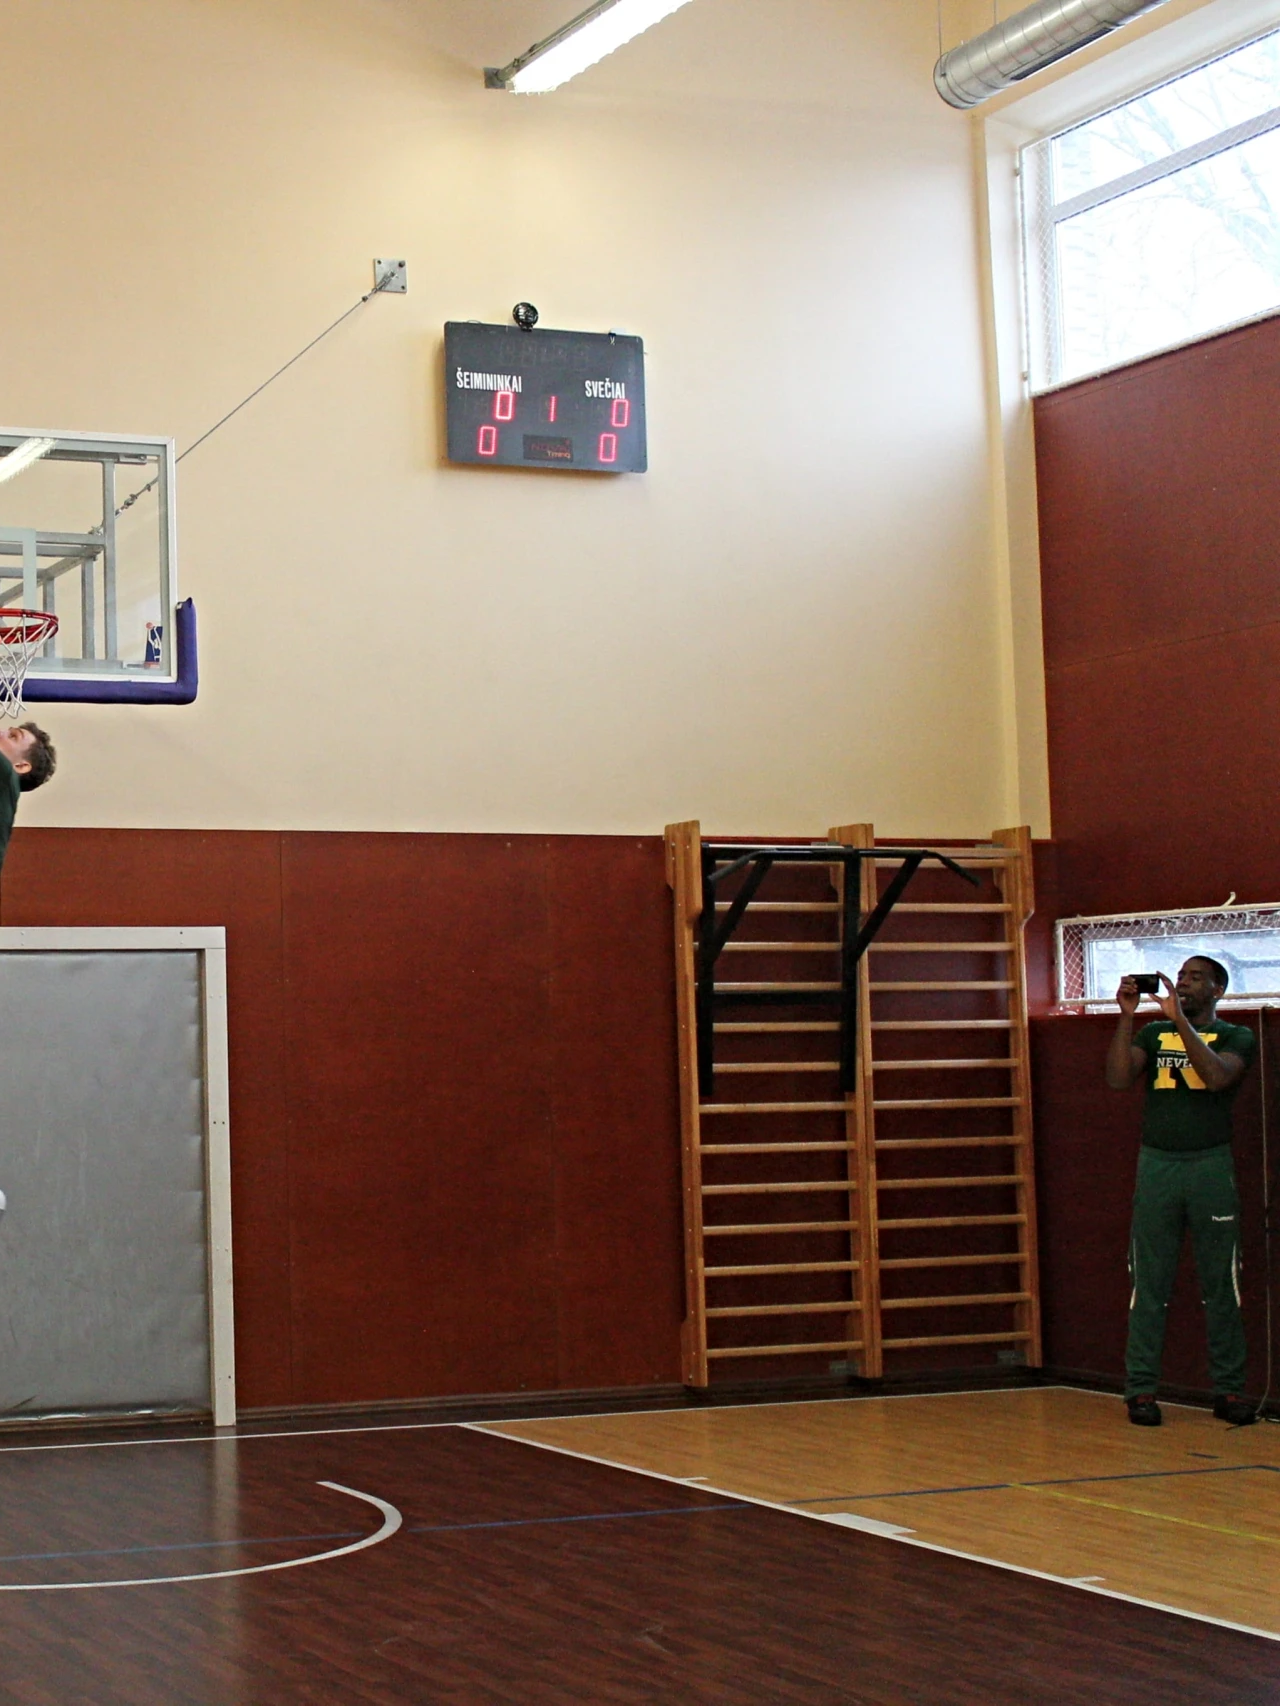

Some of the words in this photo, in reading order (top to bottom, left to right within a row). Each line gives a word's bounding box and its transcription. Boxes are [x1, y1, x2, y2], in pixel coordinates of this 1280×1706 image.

[456, 367, 522, 392] ŠEIMININKAI
[585, 378, 625, 399] SVEČIAI
[495, 391, 514, 421] 0
[611, 398, 630, 428] 0
[478, 425, 497, 455] 0
[598, 433, 617, 463] 0
